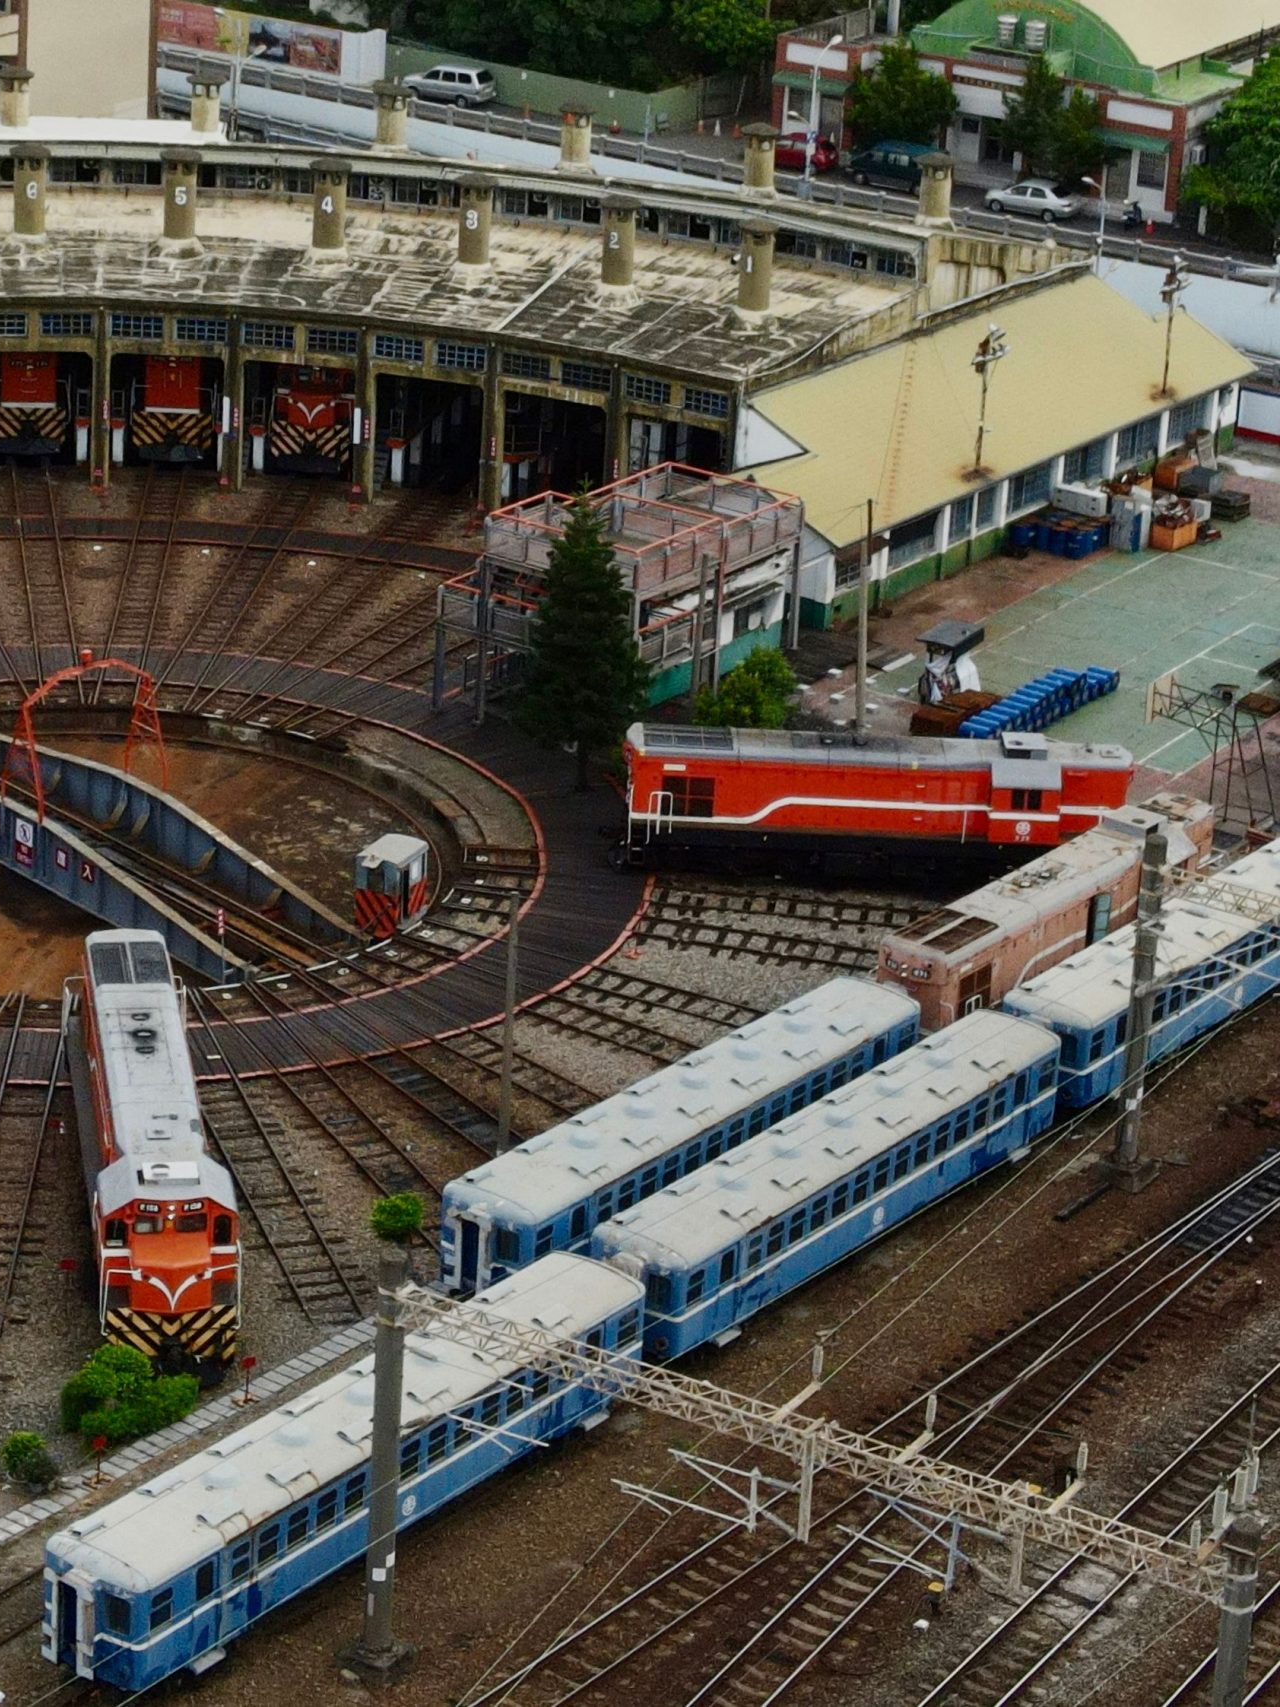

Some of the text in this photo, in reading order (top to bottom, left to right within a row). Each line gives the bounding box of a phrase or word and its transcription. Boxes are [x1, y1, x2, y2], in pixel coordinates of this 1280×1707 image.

[26, 181, 38, 199] 6
[174, 186, 187, 205] 5
[321, 196, 334, 214] 4
[465, 209, 478, 230] 3
[609, 231, 620, 249] 2
[746, 255, 753, 273] 1
